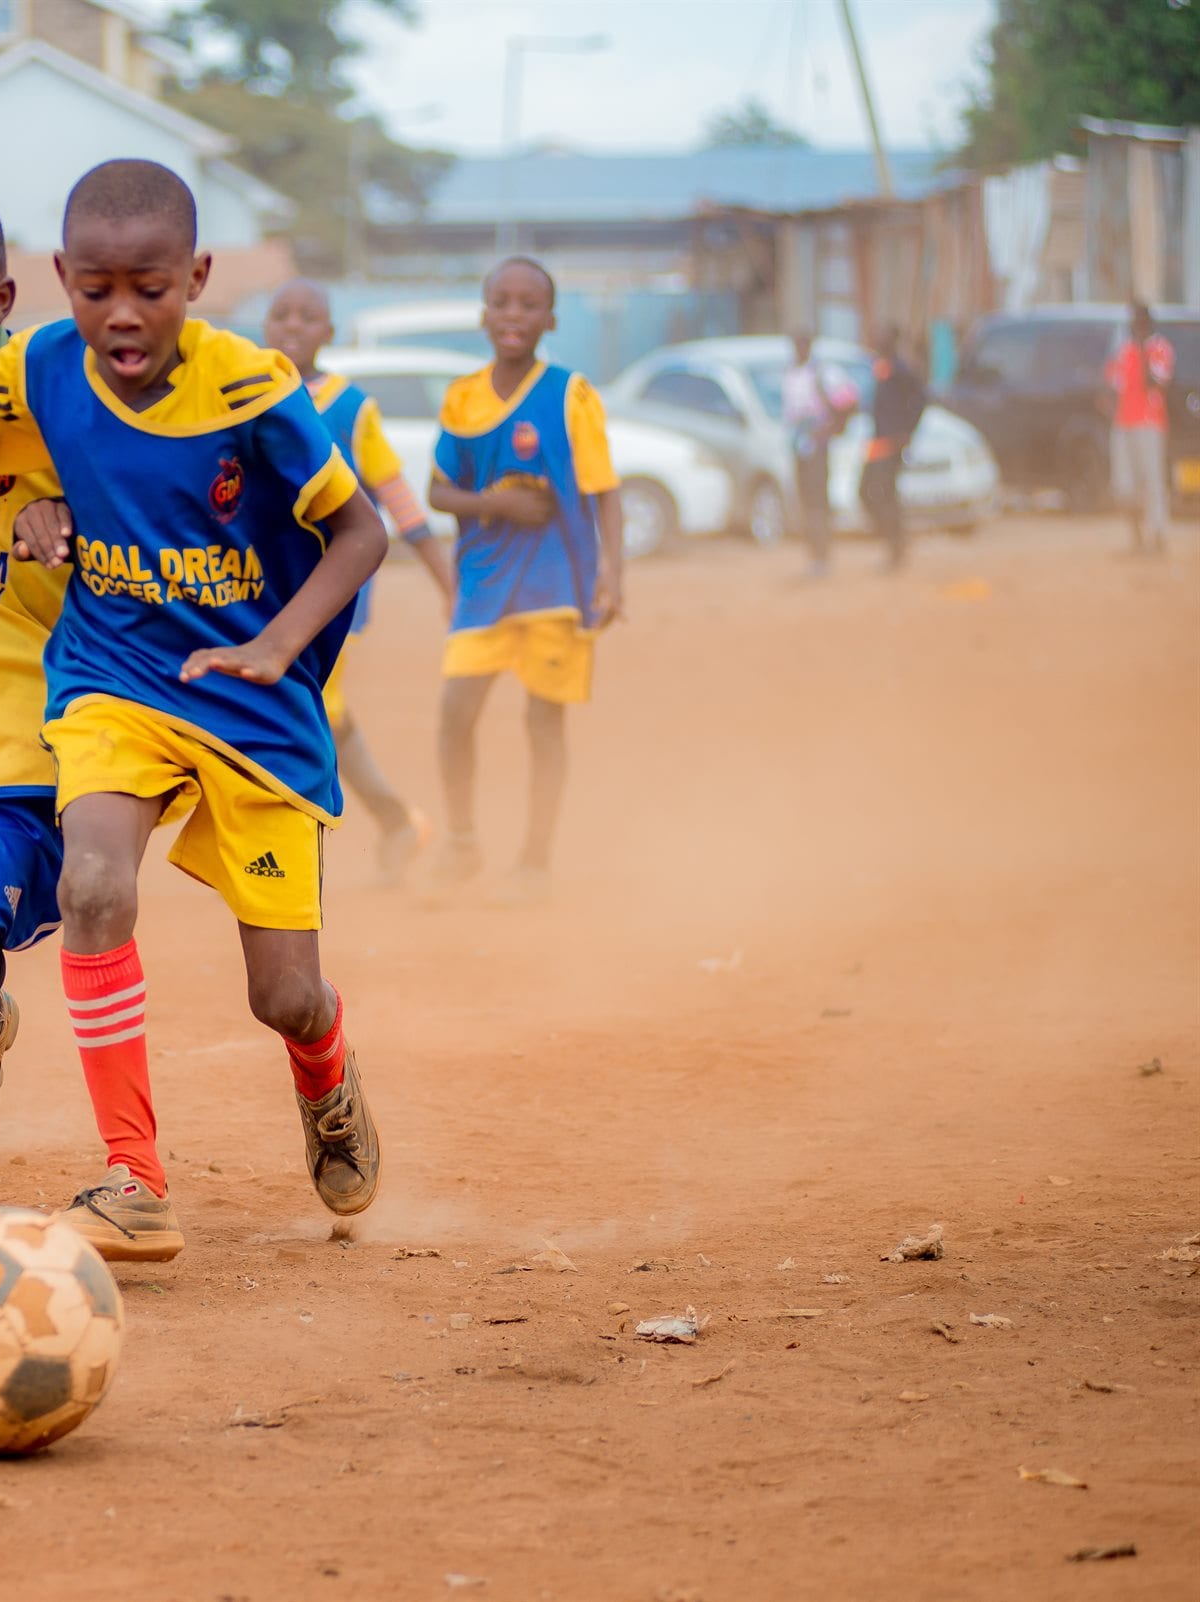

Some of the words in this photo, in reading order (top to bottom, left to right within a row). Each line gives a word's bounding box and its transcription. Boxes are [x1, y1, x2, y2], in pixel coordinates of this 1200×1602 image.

[76, 535, 153, 582] GOAL
[159, 544, 264, 585] DREAM
[81, 570, 164, 605] SOCCER
[166, 580, 265, 608] ACADEMY
[244, 865, 286, 878] adidas
